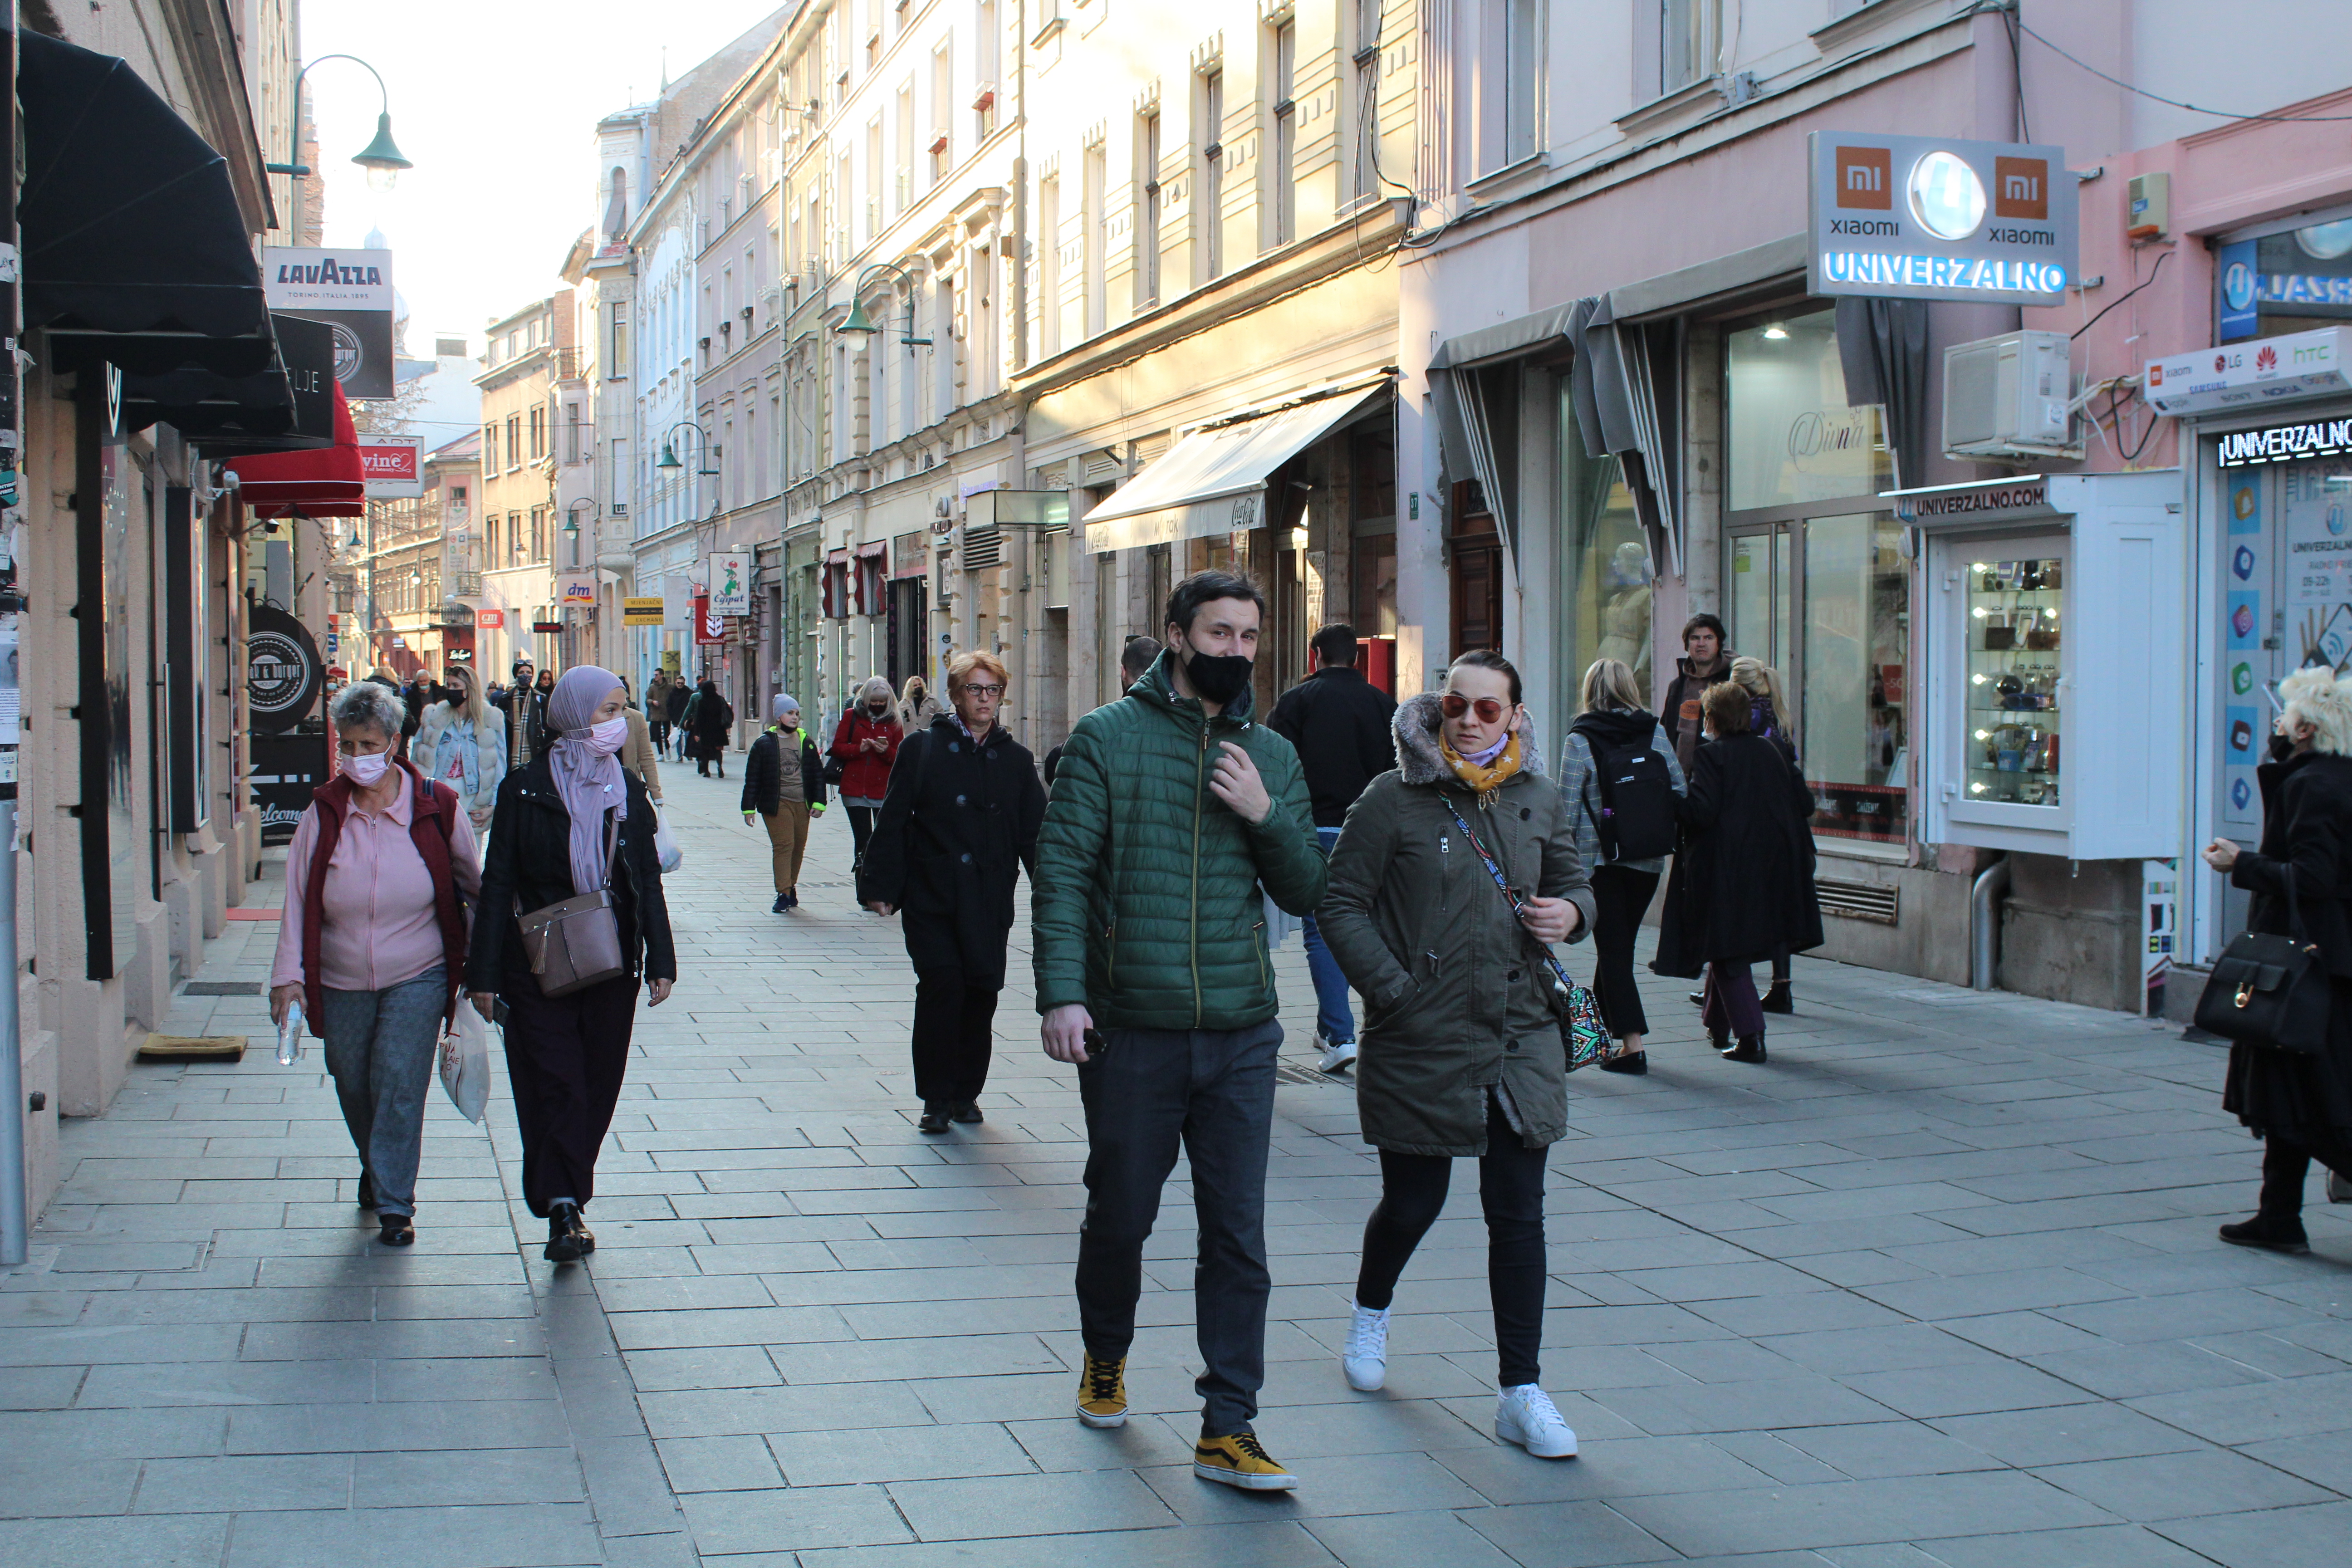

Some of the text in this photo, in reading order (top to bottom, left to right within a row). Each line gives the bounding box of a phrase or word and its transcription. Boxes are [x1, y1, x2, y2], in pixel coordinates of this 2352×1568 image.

[1830, 219, 1899, 236] xiaomi
[1989, 227, 2055, 246] xiaomi
[277, 258, 382, 285] LAVAZZA
[1824, 251, 2067, 294] UNIVERZALNO
[2229, 354, 2242, 368] LG
[1917, 487, 2044, 516] UNIVERZALNO.COM
[568, 583, 589, 596] dm
